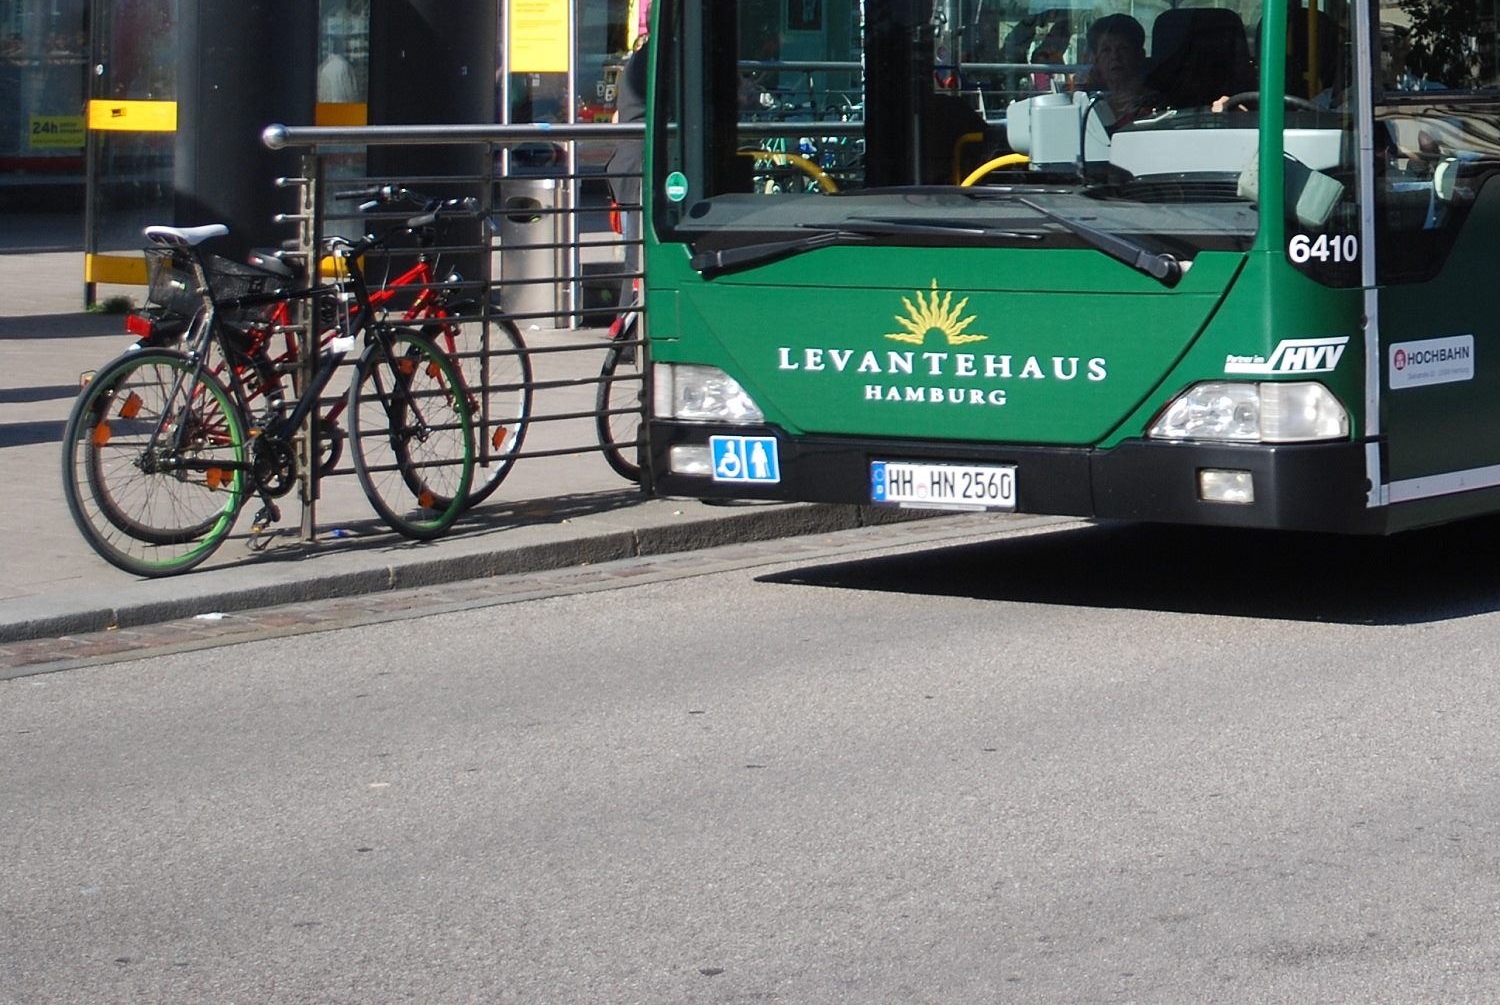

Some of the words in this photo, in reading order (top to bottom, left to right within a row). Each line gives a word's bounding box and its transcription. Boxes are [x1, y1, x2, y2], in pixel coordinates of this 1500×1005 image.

[33, 122, 58, 134] 24h
[1289, 234, 1358, 263] 6410
[778, 347, 1108, 381] LEVANTEHAUS
[1280, 344, 1346, 370] HVV
[1407, 346, 1470, 365] HOCHBAHN
[865, 385, 1008, 405] HAMBURG
[889, 469, 913, 496] HH
[930, 471, 956, 498] HN
[962, 472, 1012, 499] 2560
